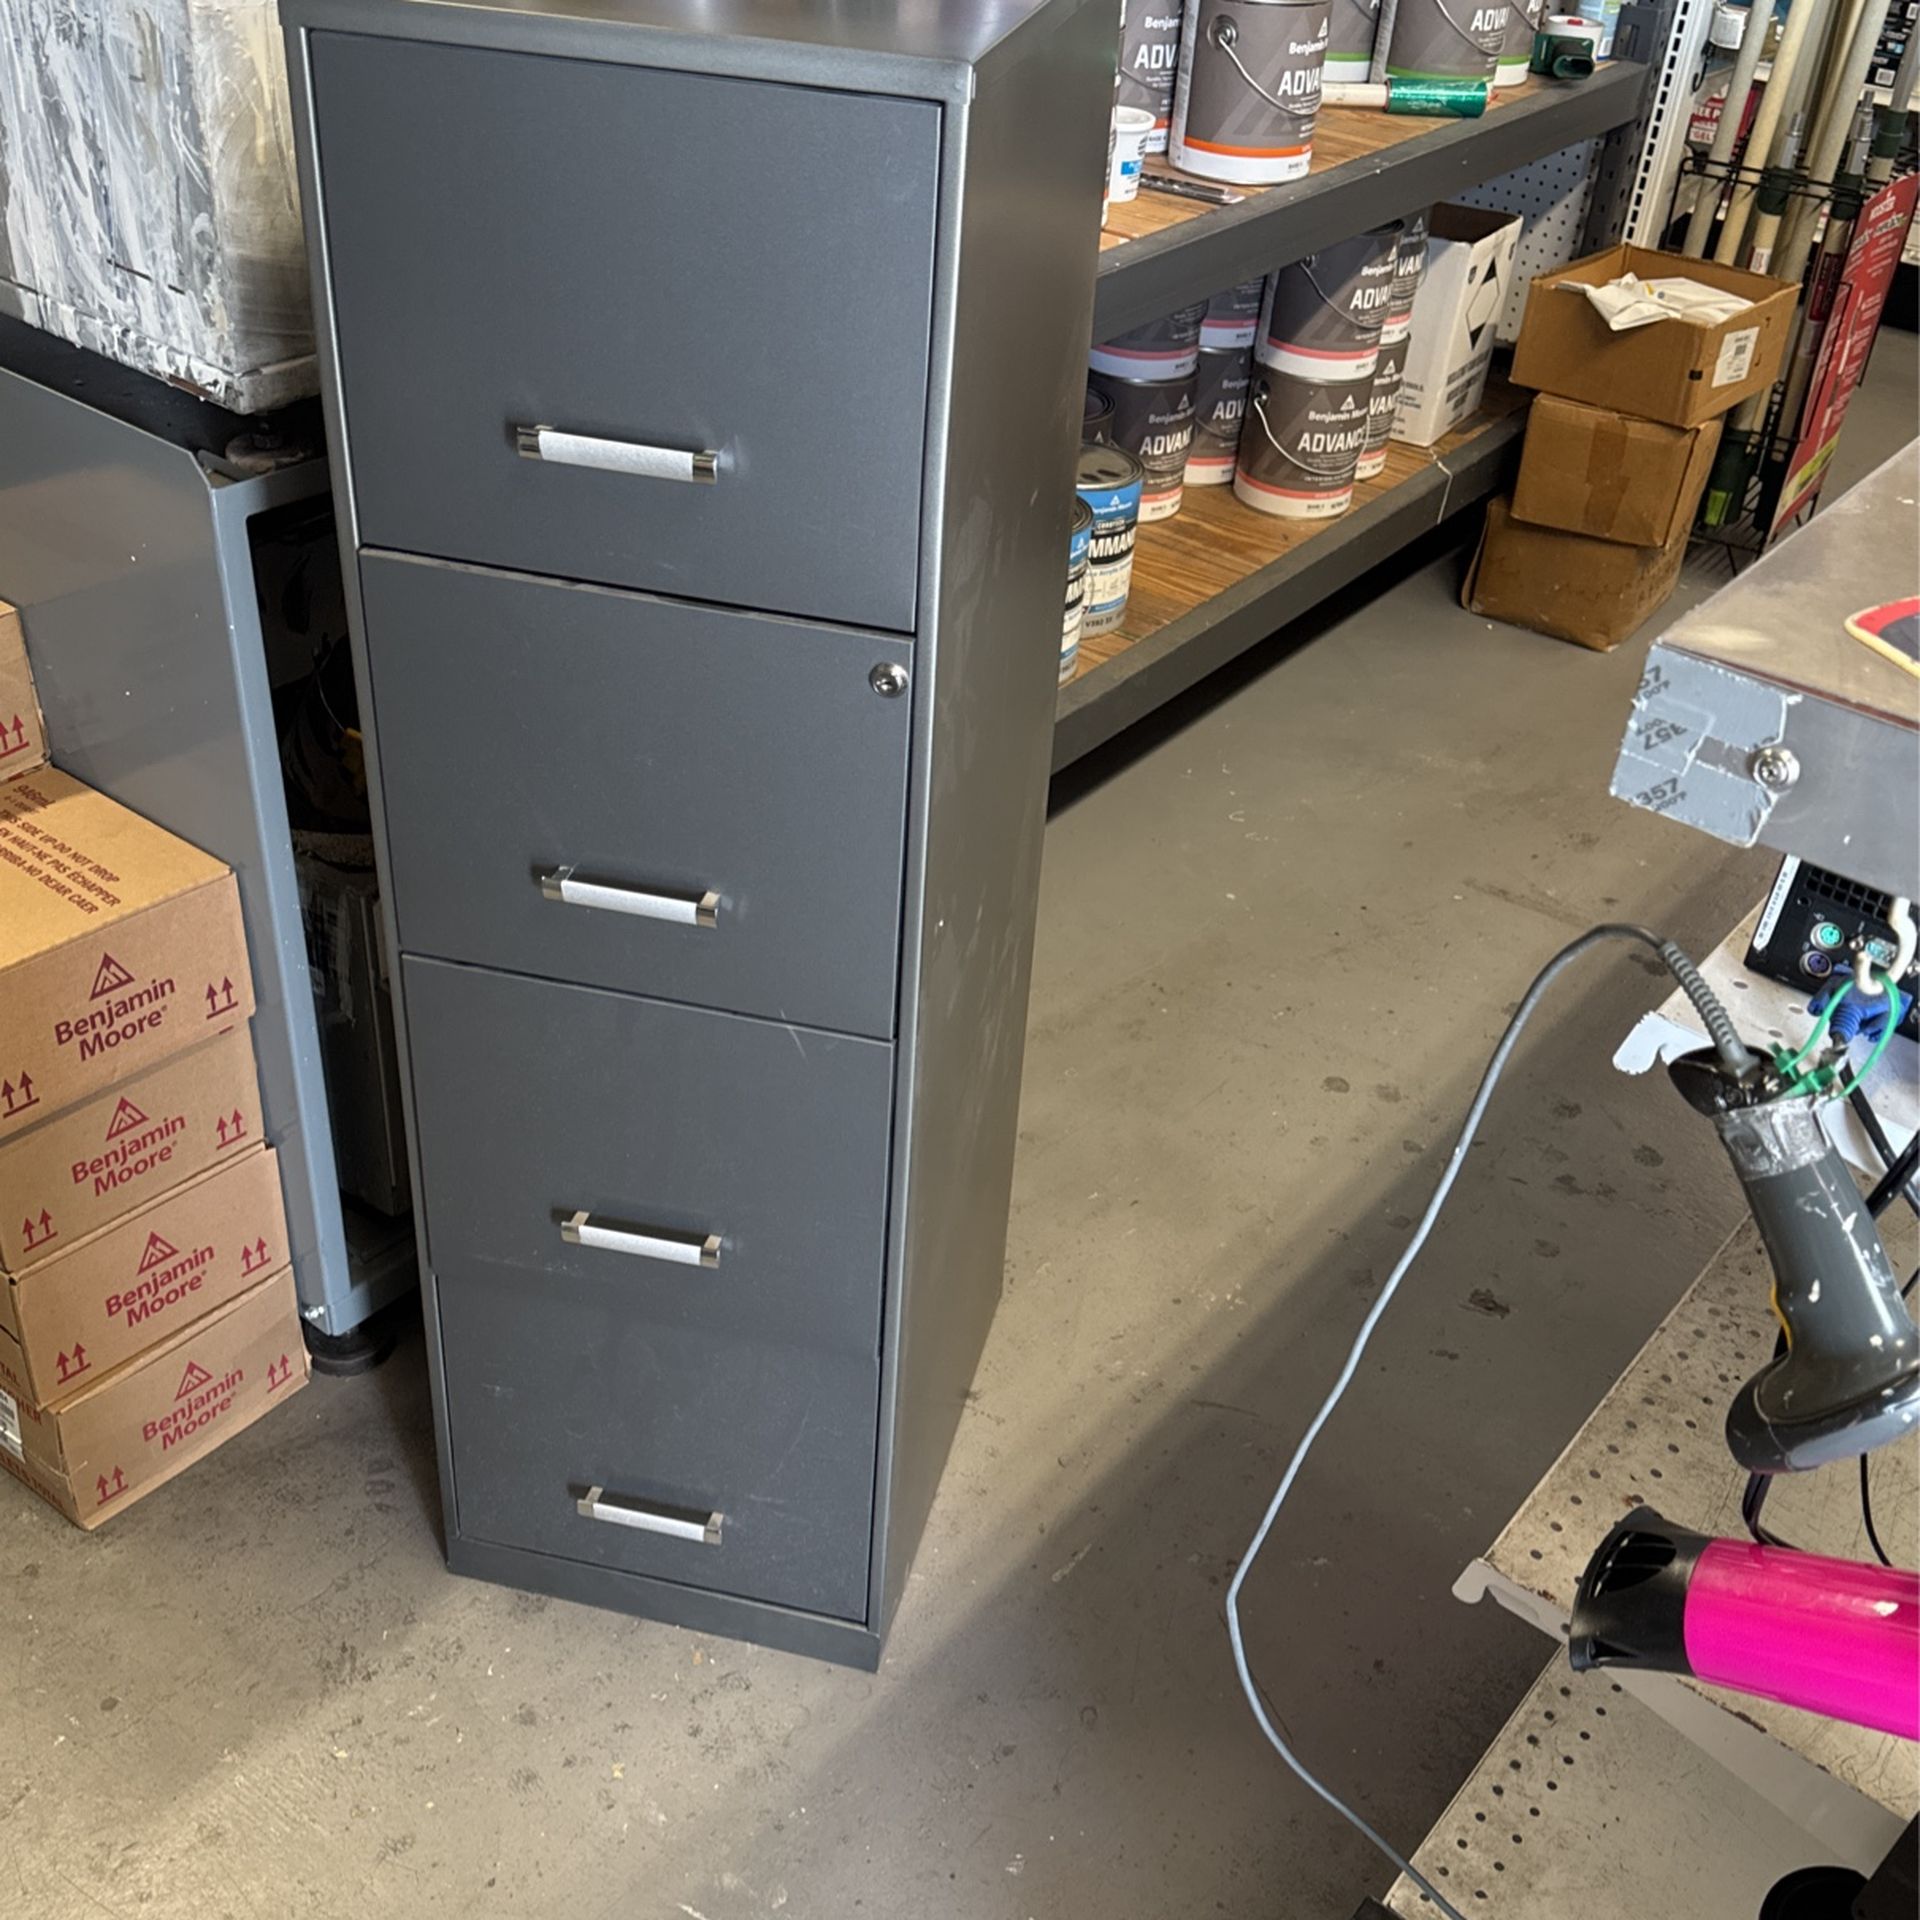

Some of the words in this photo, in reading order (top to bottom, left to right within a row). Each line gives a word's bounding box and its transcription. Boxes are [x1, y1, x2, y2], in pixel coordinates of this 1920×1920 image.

[1308, 410, 1350, 424] Benjamin
[1635, 777, 1678, 805] 357
[17, 821, 44, 837] SIDE
[67, 851, 94, 867] NOT
[88, 864, 120, 882] DROP
[54, 977, 176, 1045] Benjamin
[71, 1115, 186, 1184] Benjamin
[105, 1245, 215, 1318] Benjamin
[142, 1368, 244, 1442] Benjamin
